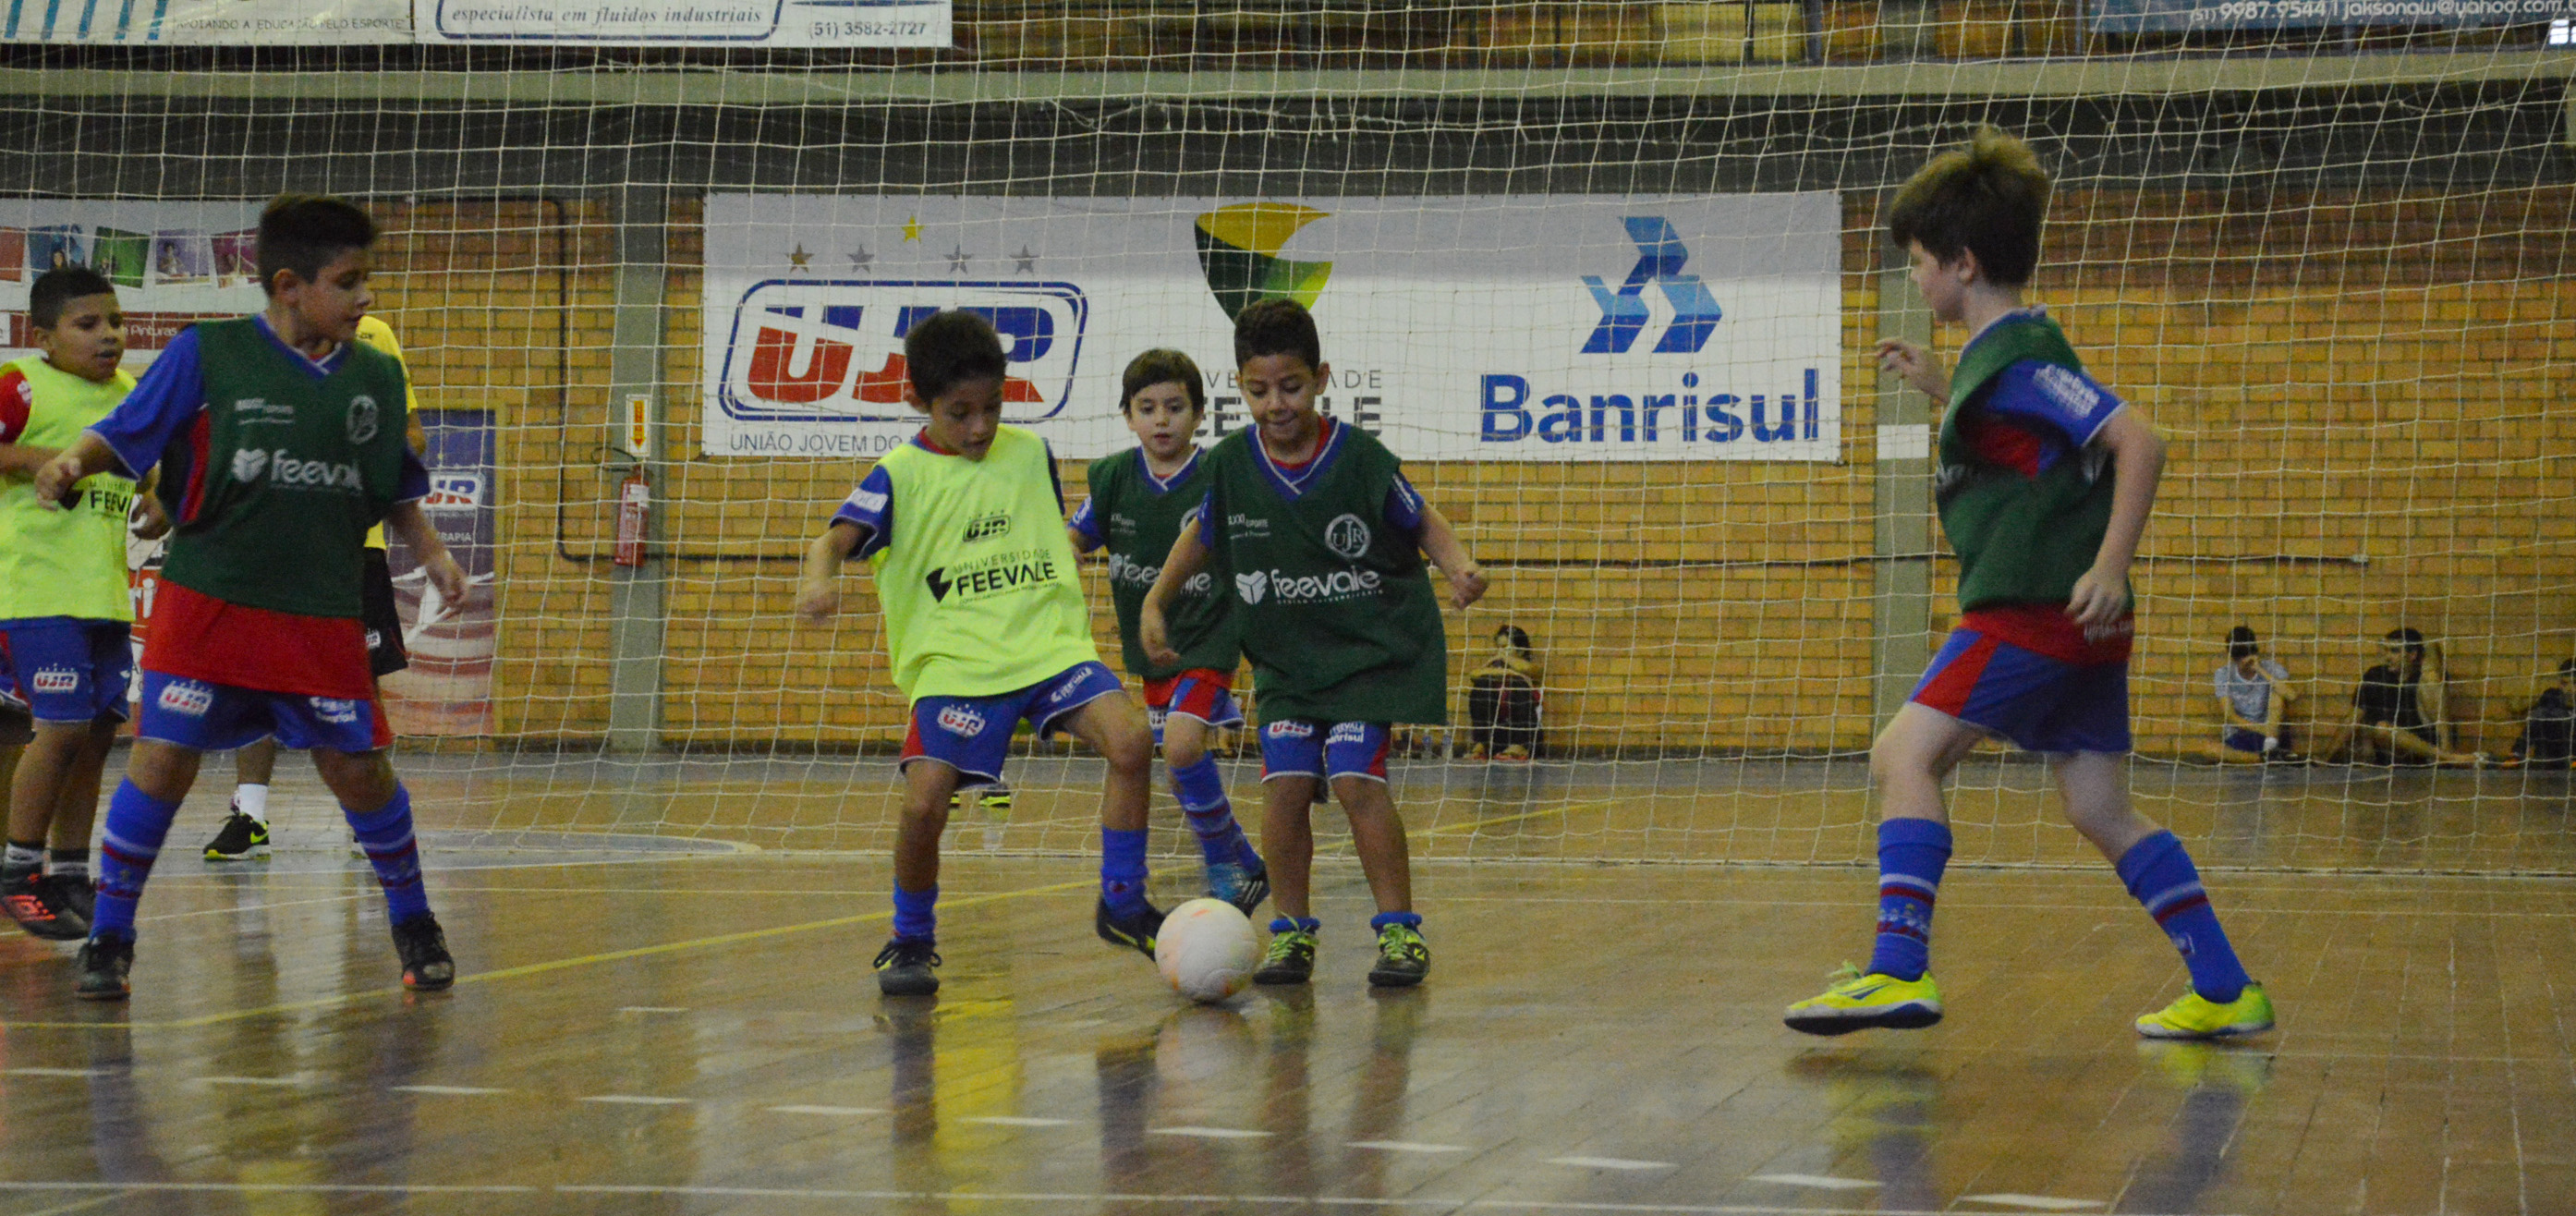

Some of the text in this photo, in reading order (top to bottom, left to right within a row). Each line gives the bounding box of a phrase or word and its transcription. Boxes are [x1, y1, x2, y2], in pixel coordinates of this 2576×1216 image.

[452, 6, 762, 24] especialista em fluidos industriais
[2219, 0, 2327, 19] 9987.9544
[809, 20, 927, 39] (51) 3582-2727
[1480, 368, 1819, 443] Banrisul
[730, 431, 793, 451] UNIÃO
[798, 434, 868, 452] JOVEM
[956, 561, 1058, 597] FEEVALE
[1270, 565, 1381, 599] feevale
